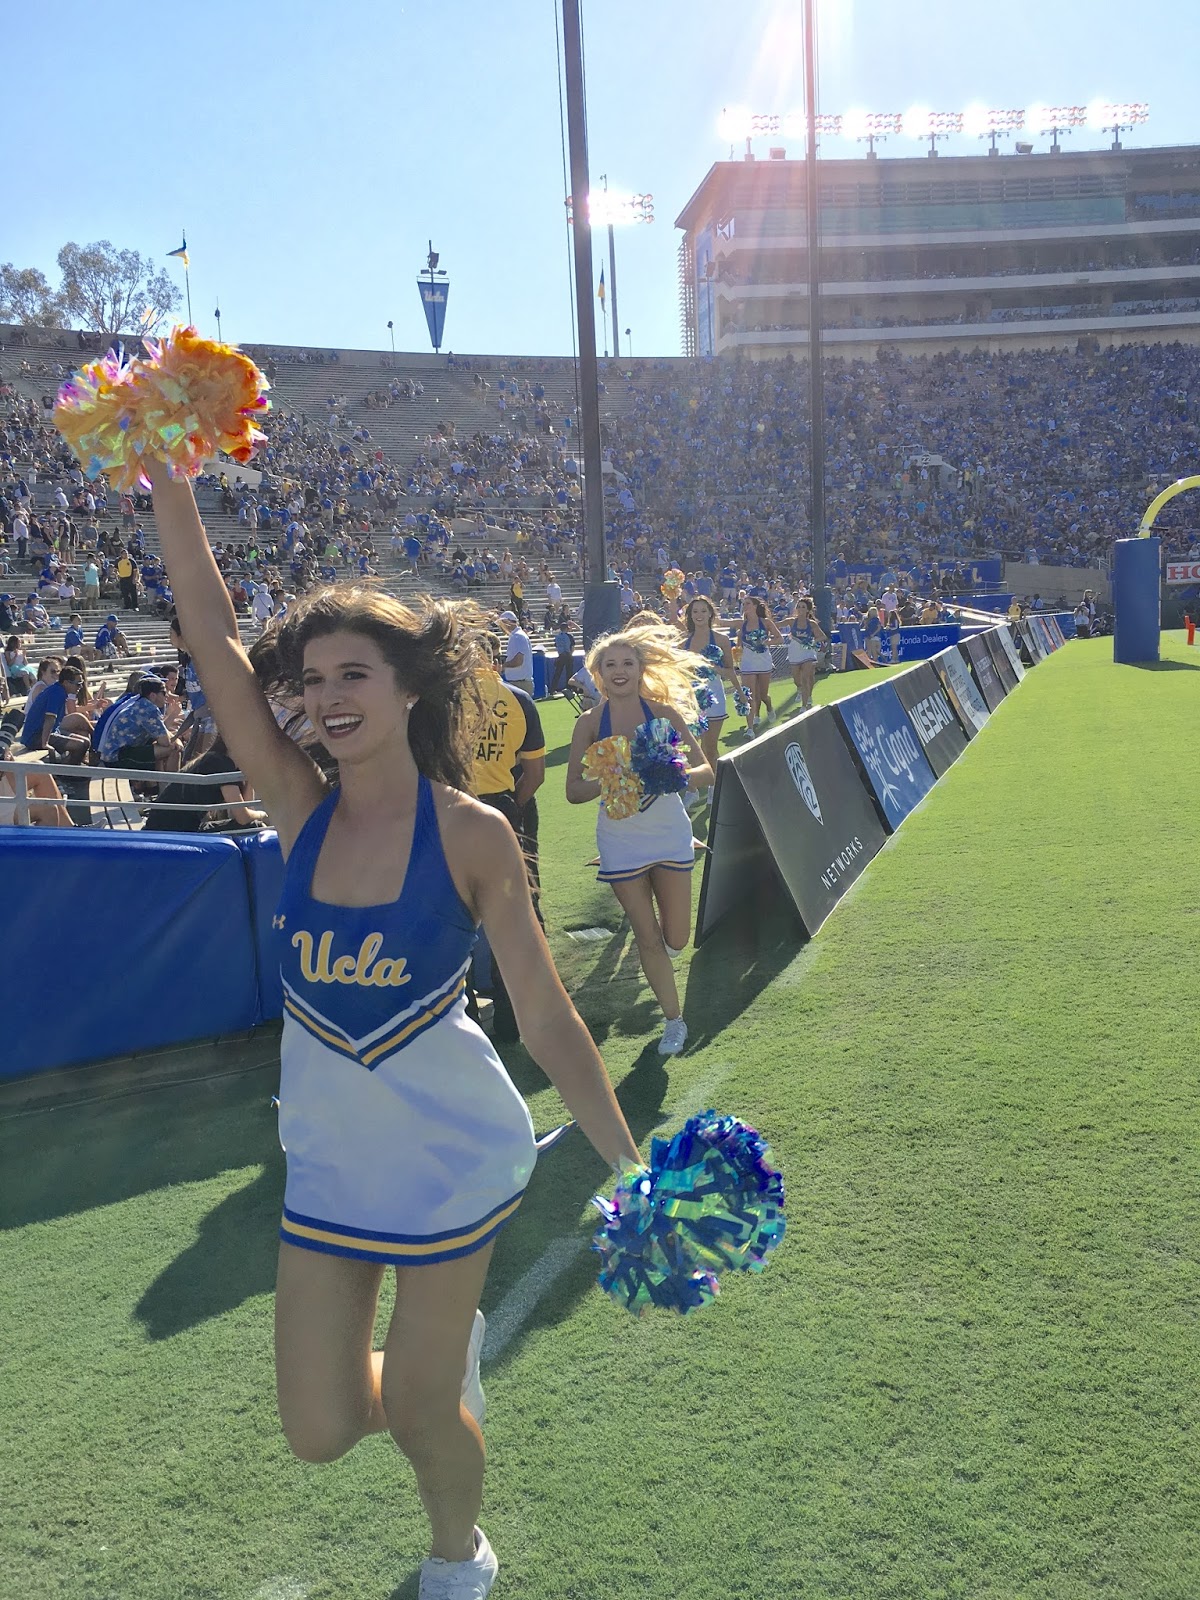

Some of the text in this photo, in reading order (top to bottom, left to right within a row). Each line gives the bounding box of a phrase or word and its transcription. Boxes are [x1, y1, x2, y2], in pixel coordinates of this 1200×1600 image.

[898, 634, 921, 645] Honda
[922, 633, 949, 644] Dealers
[908, 689, 954, 747] NISSAN
[876, 724, 920, 782] Cigna
[820, 836, 863, 890] NETWORKS
[291, 930, 412, 987] Ucla
